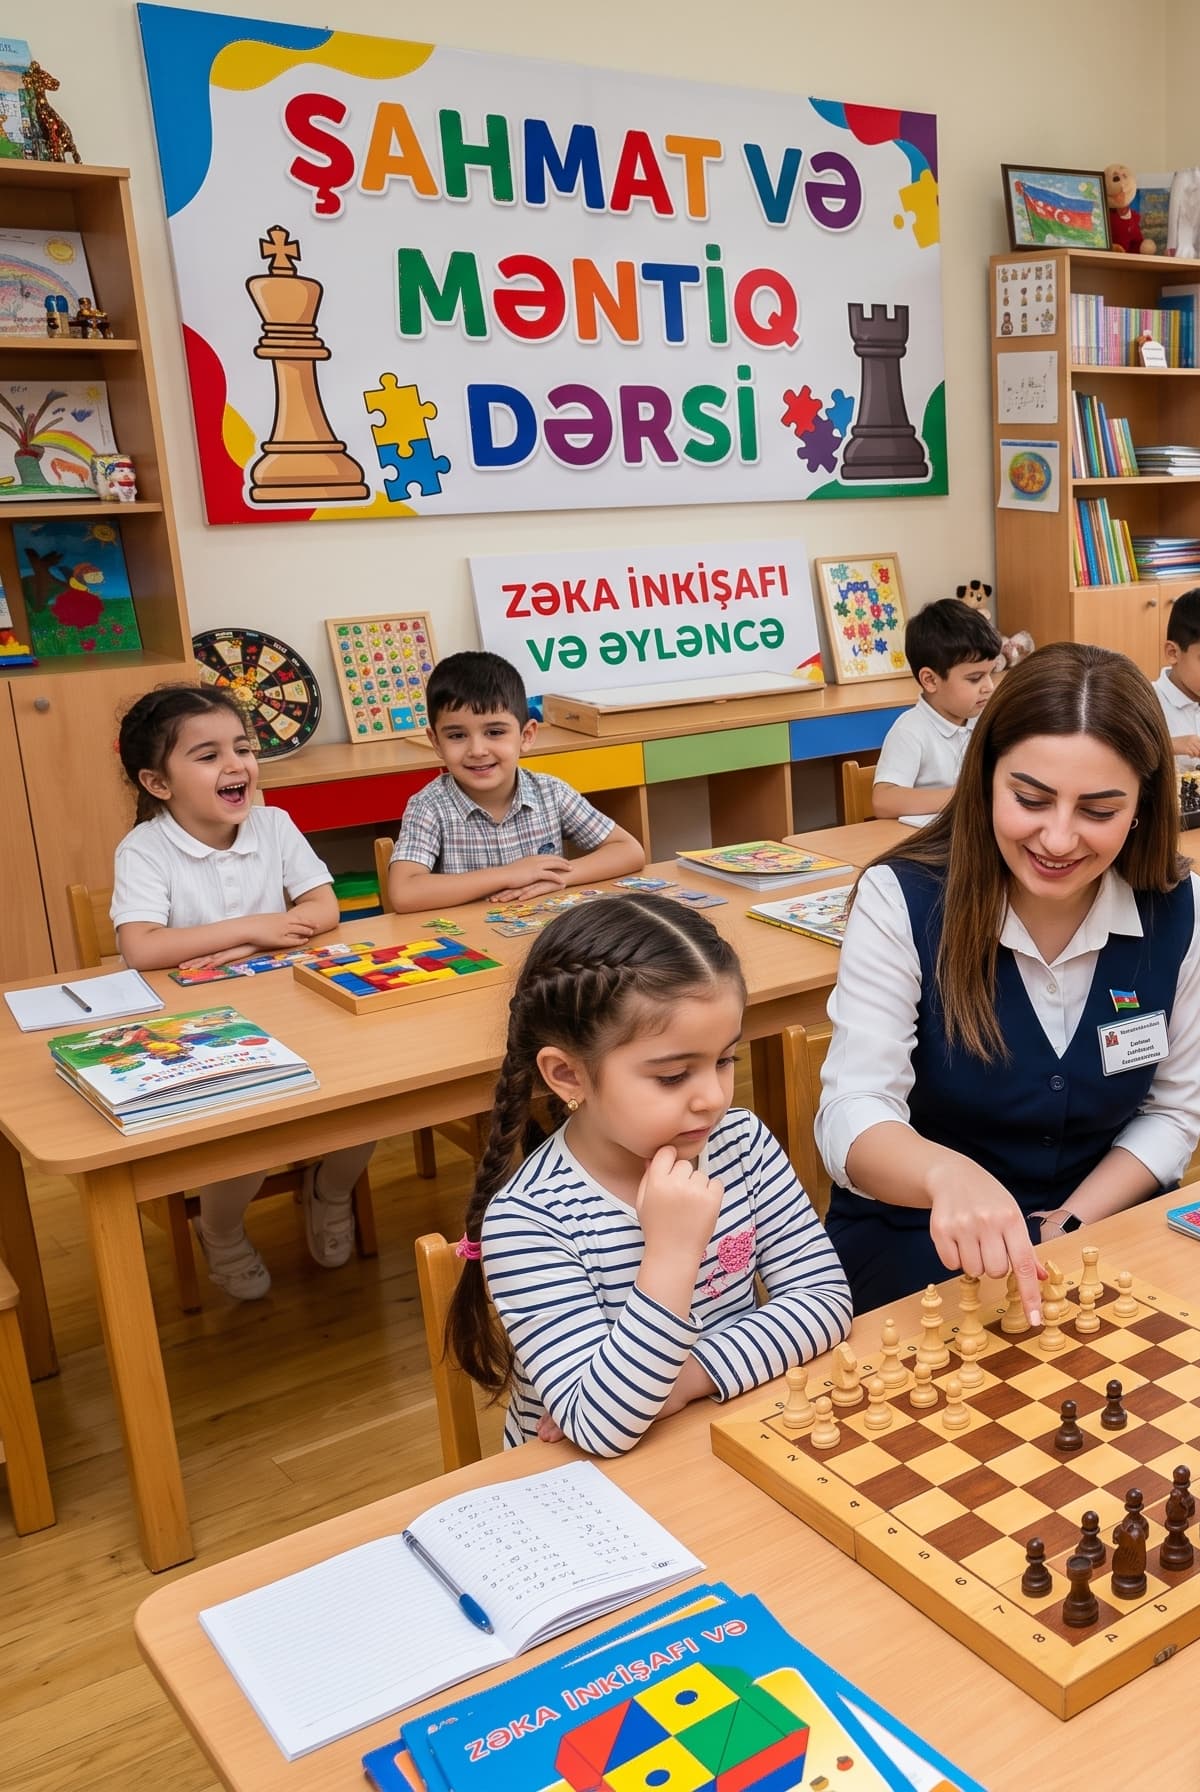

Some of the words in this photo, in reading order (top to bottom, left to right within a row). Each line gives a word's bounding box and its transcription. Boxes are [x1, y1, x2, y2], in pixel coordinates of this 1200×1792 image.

[284, 92, 722, 218] ŞAHMAT
[743, 143, 862, 230] VƏ
[398, 243, 800, 349] MƏNTİQ
[467, 364, 757, 469] DƏRSİ
[501, 577, 621, 619] ZƏKA
[627, 562, 790, 611] İNKİŞAFI
[526, 634, 588, 673] VƏ
[599, 616, 786, 666] ƏYLƏNCƏ
[918, 1550, 931, 1560] 5
[992, 1604, 1006, 1615] 7
[1032, 1633, 1046, 1643] 8
[464, 1705, 561, 1762] ZƏKA
[560, 1636, 701, 1711] İNKİŞAFI
[700, 1618, 749, 1645] VƏ
